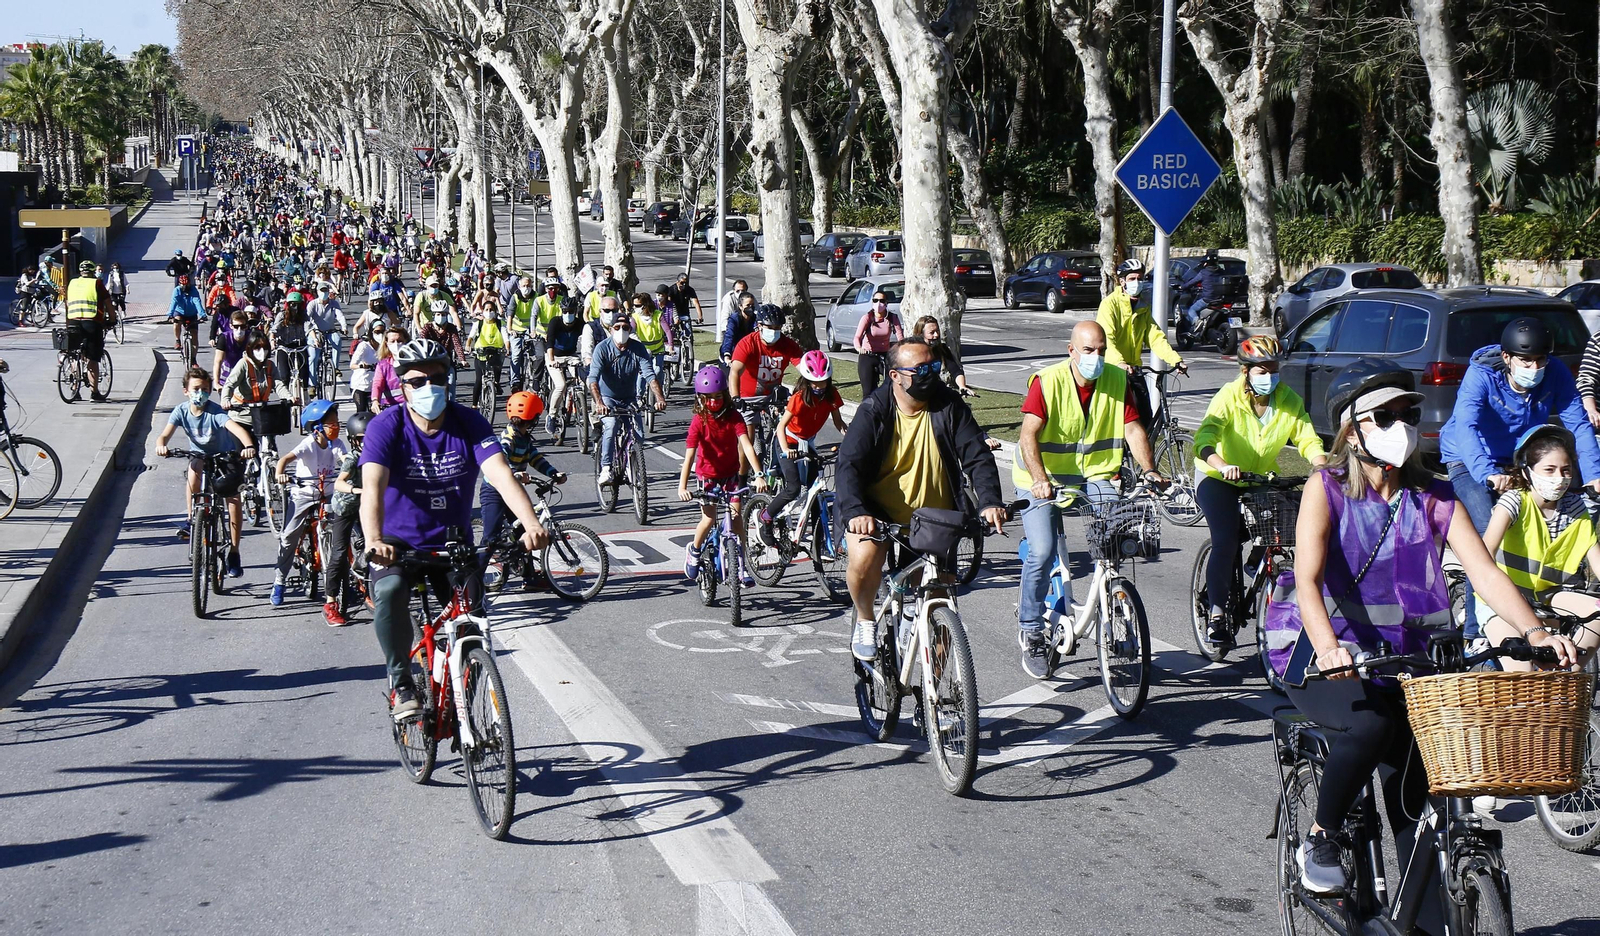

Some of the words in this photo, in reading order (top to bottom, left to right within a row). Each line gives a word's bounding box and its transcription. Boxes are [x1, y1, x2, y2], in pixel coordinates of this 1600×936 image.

[181, 140, 191, 152] P
[1153, 154, 1187, 169] RED
[1137, 173, 1200, 189] BASICA
[759, 355, 783, 368] JUST
[758, 368, 782, 381] DO
